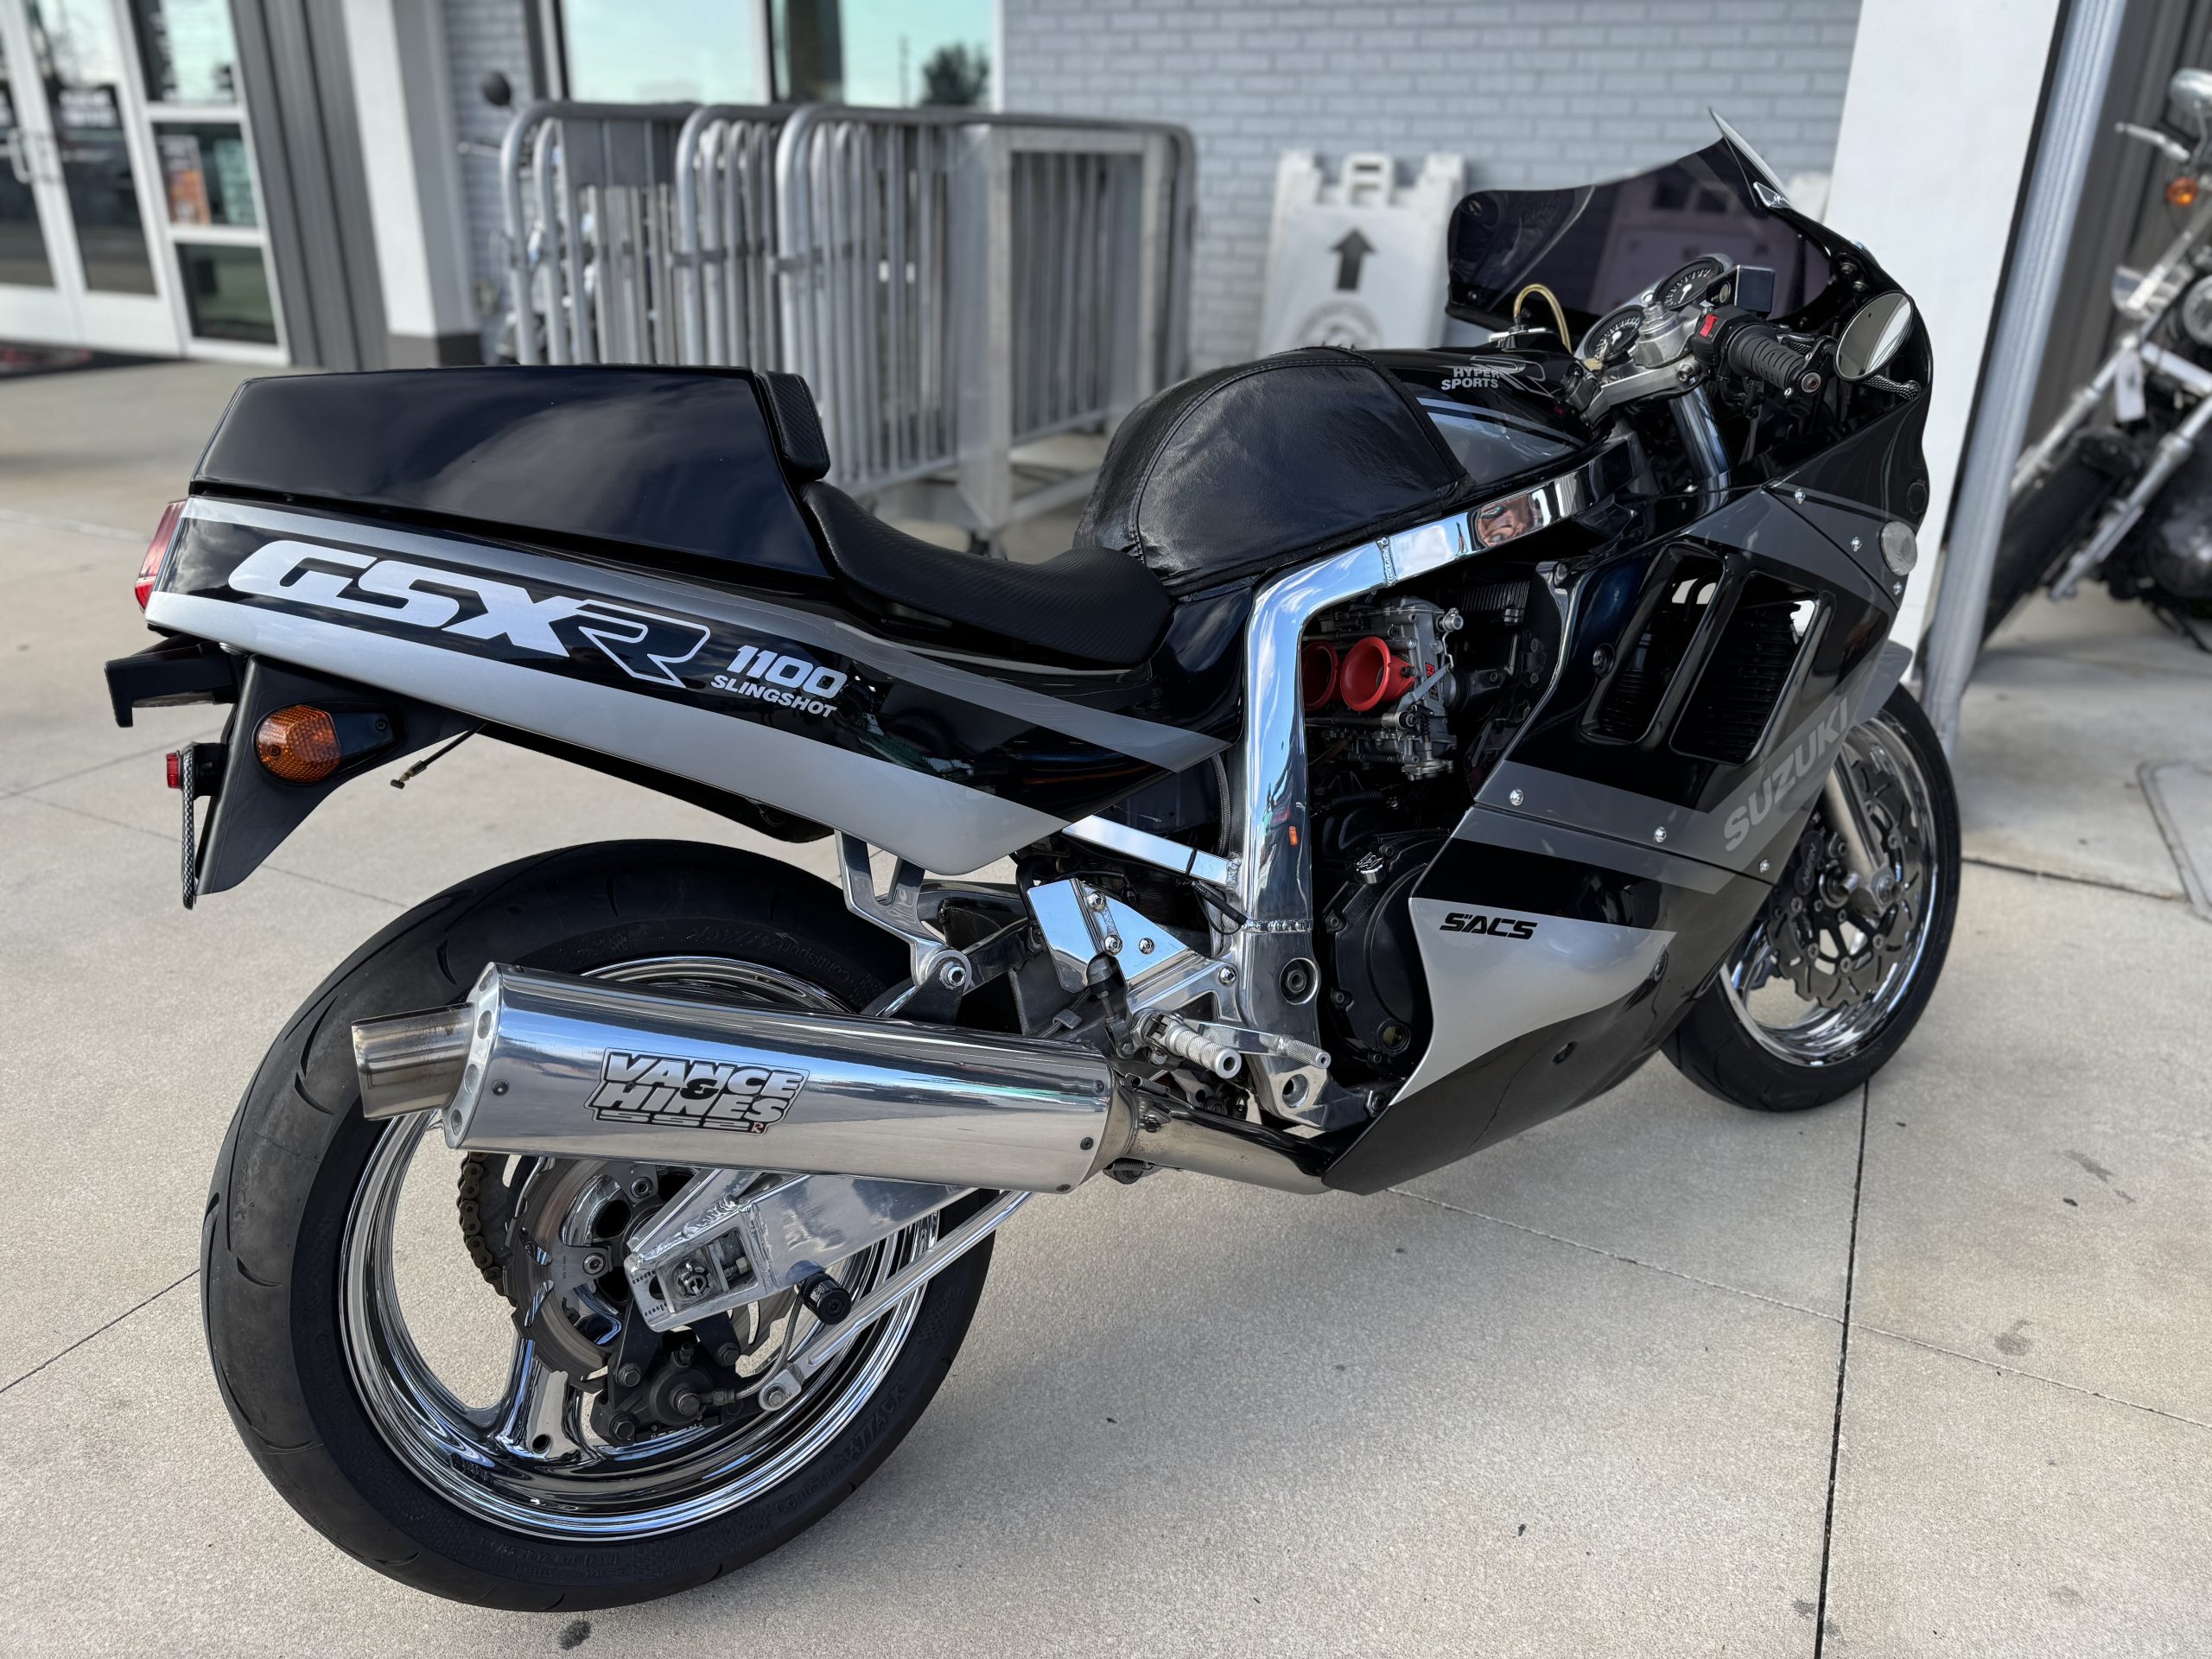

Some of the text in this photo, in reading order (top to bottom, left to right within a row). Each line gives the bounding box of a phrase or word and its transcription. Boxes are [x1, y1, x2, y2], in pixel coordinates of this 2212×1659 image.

[1440, 378, 1499, 391] SPORTS
[1452, 367, 1502, 378] HYPER
[727, 645, 848, 699] 1100
[710, 675, 838, 718] SLINGSHOT
[1724, 697, 1848, 851] SUZUKI
[1440, 912, 1538, 940] SACS
[605, 1052, 805, 1100] VANCE
[588, 1082, 788, 1123] HINES
